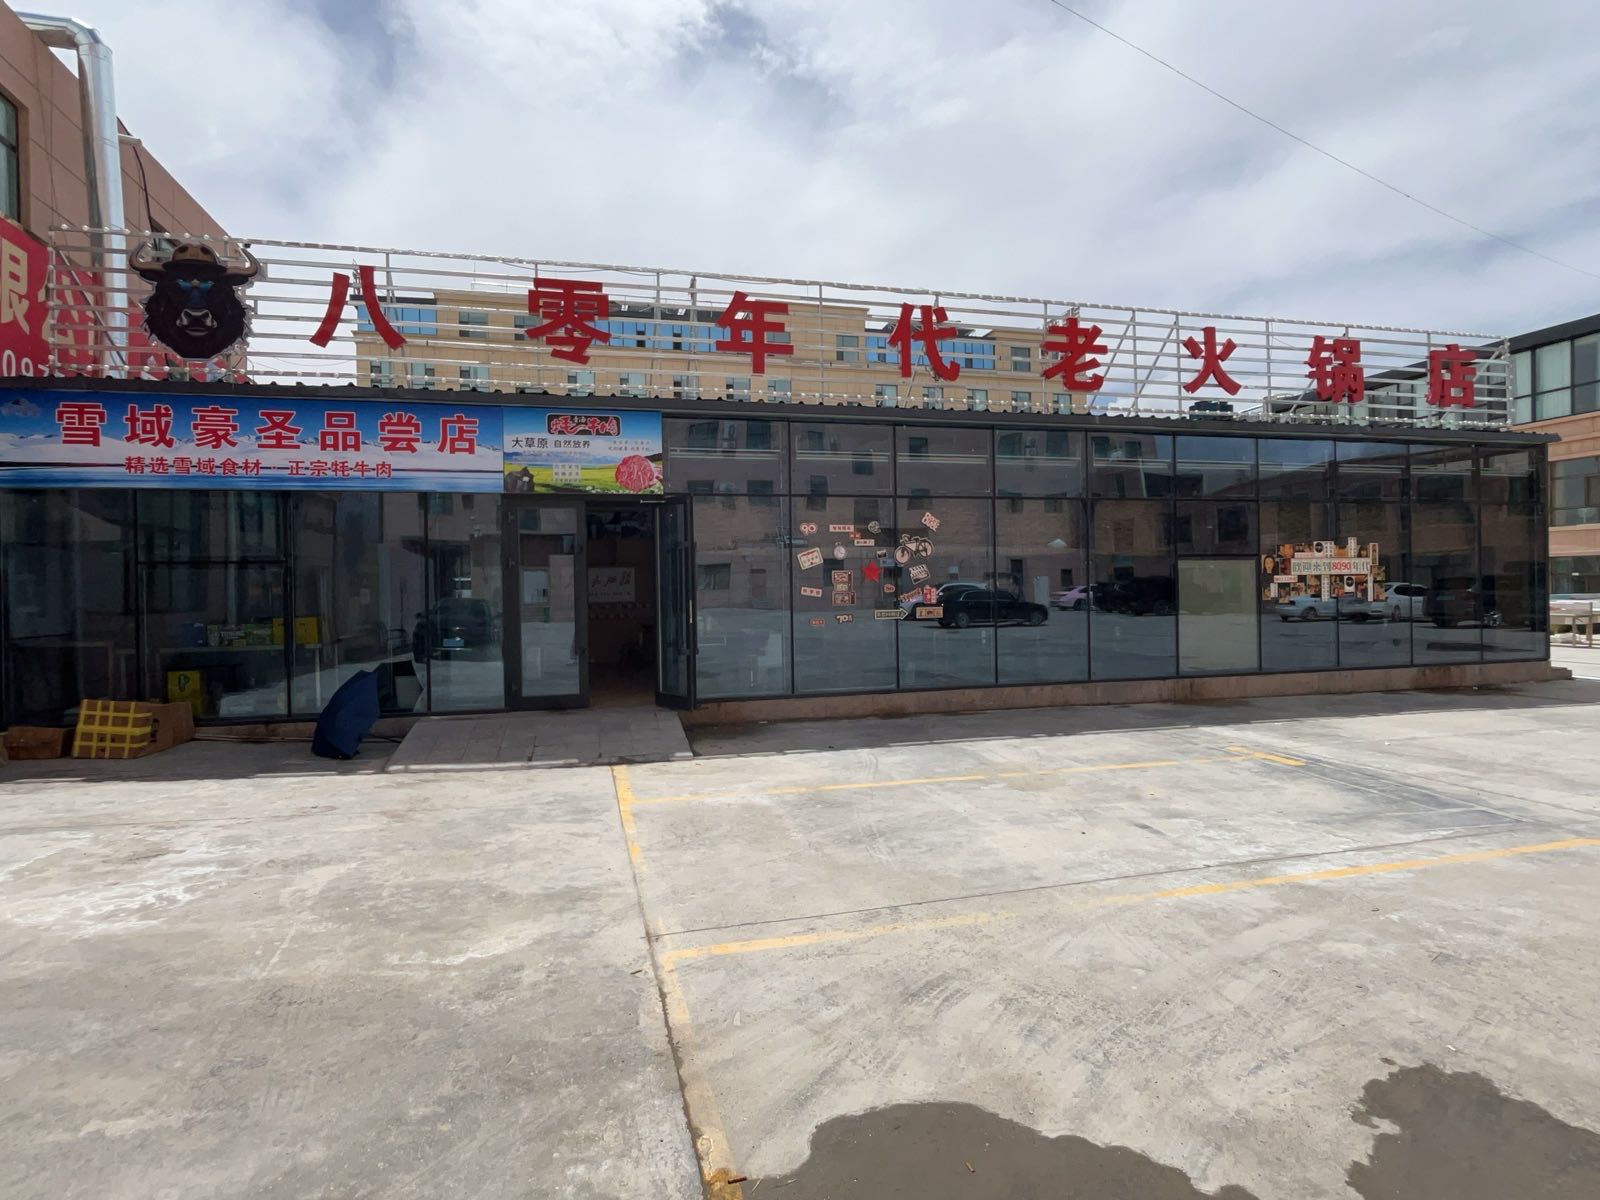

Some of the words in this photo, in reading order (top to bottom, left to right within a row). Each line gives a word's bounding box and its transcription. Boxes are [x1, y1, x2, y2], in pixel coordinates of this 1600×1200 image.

[310, 265, 1477, 409] 八零年代老火锅店
[55, 402, 478, 455] 雪域豪圣品尝店
[512, 437, 548, 449] 大草原
[554, 439, 591, 449] 自然放养
